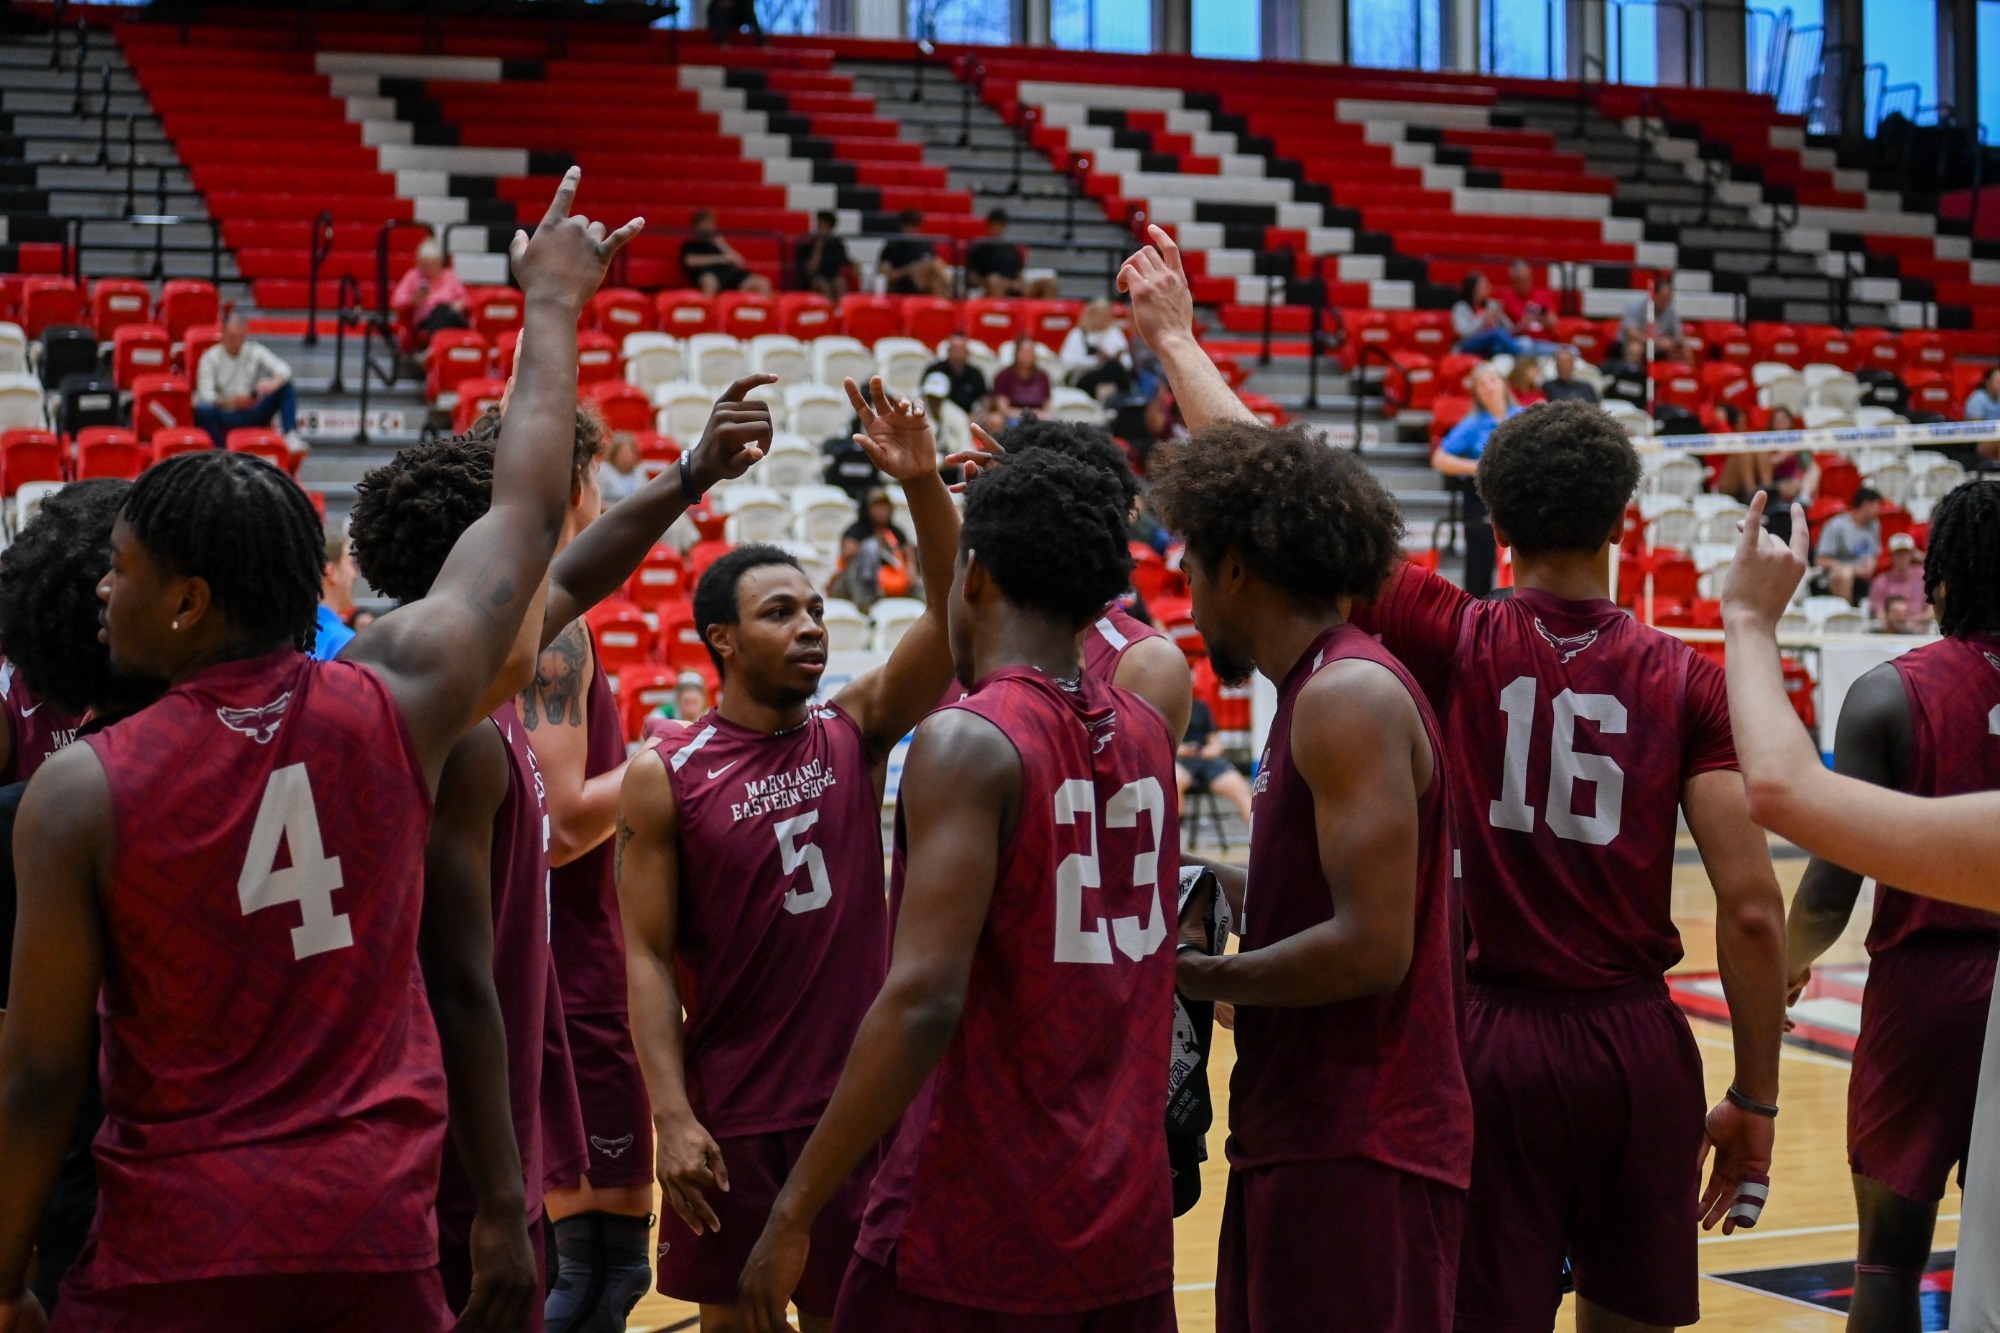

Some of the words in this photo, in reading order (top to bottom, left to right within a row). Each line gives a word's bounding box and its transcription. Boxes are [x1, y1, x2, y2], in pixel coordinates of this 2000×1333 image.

[730, 787, 803, 822] EASTERN
[744, 758, 822, 799] MARYLAND
[1489, 676, 1627, 846] 16
[238, 762, 353, 960] 4
[774, 809, 832, 914] 5
[1054, 776, 1167, 964] 23
[1179, 1088, 1192, 1108] SPORT
